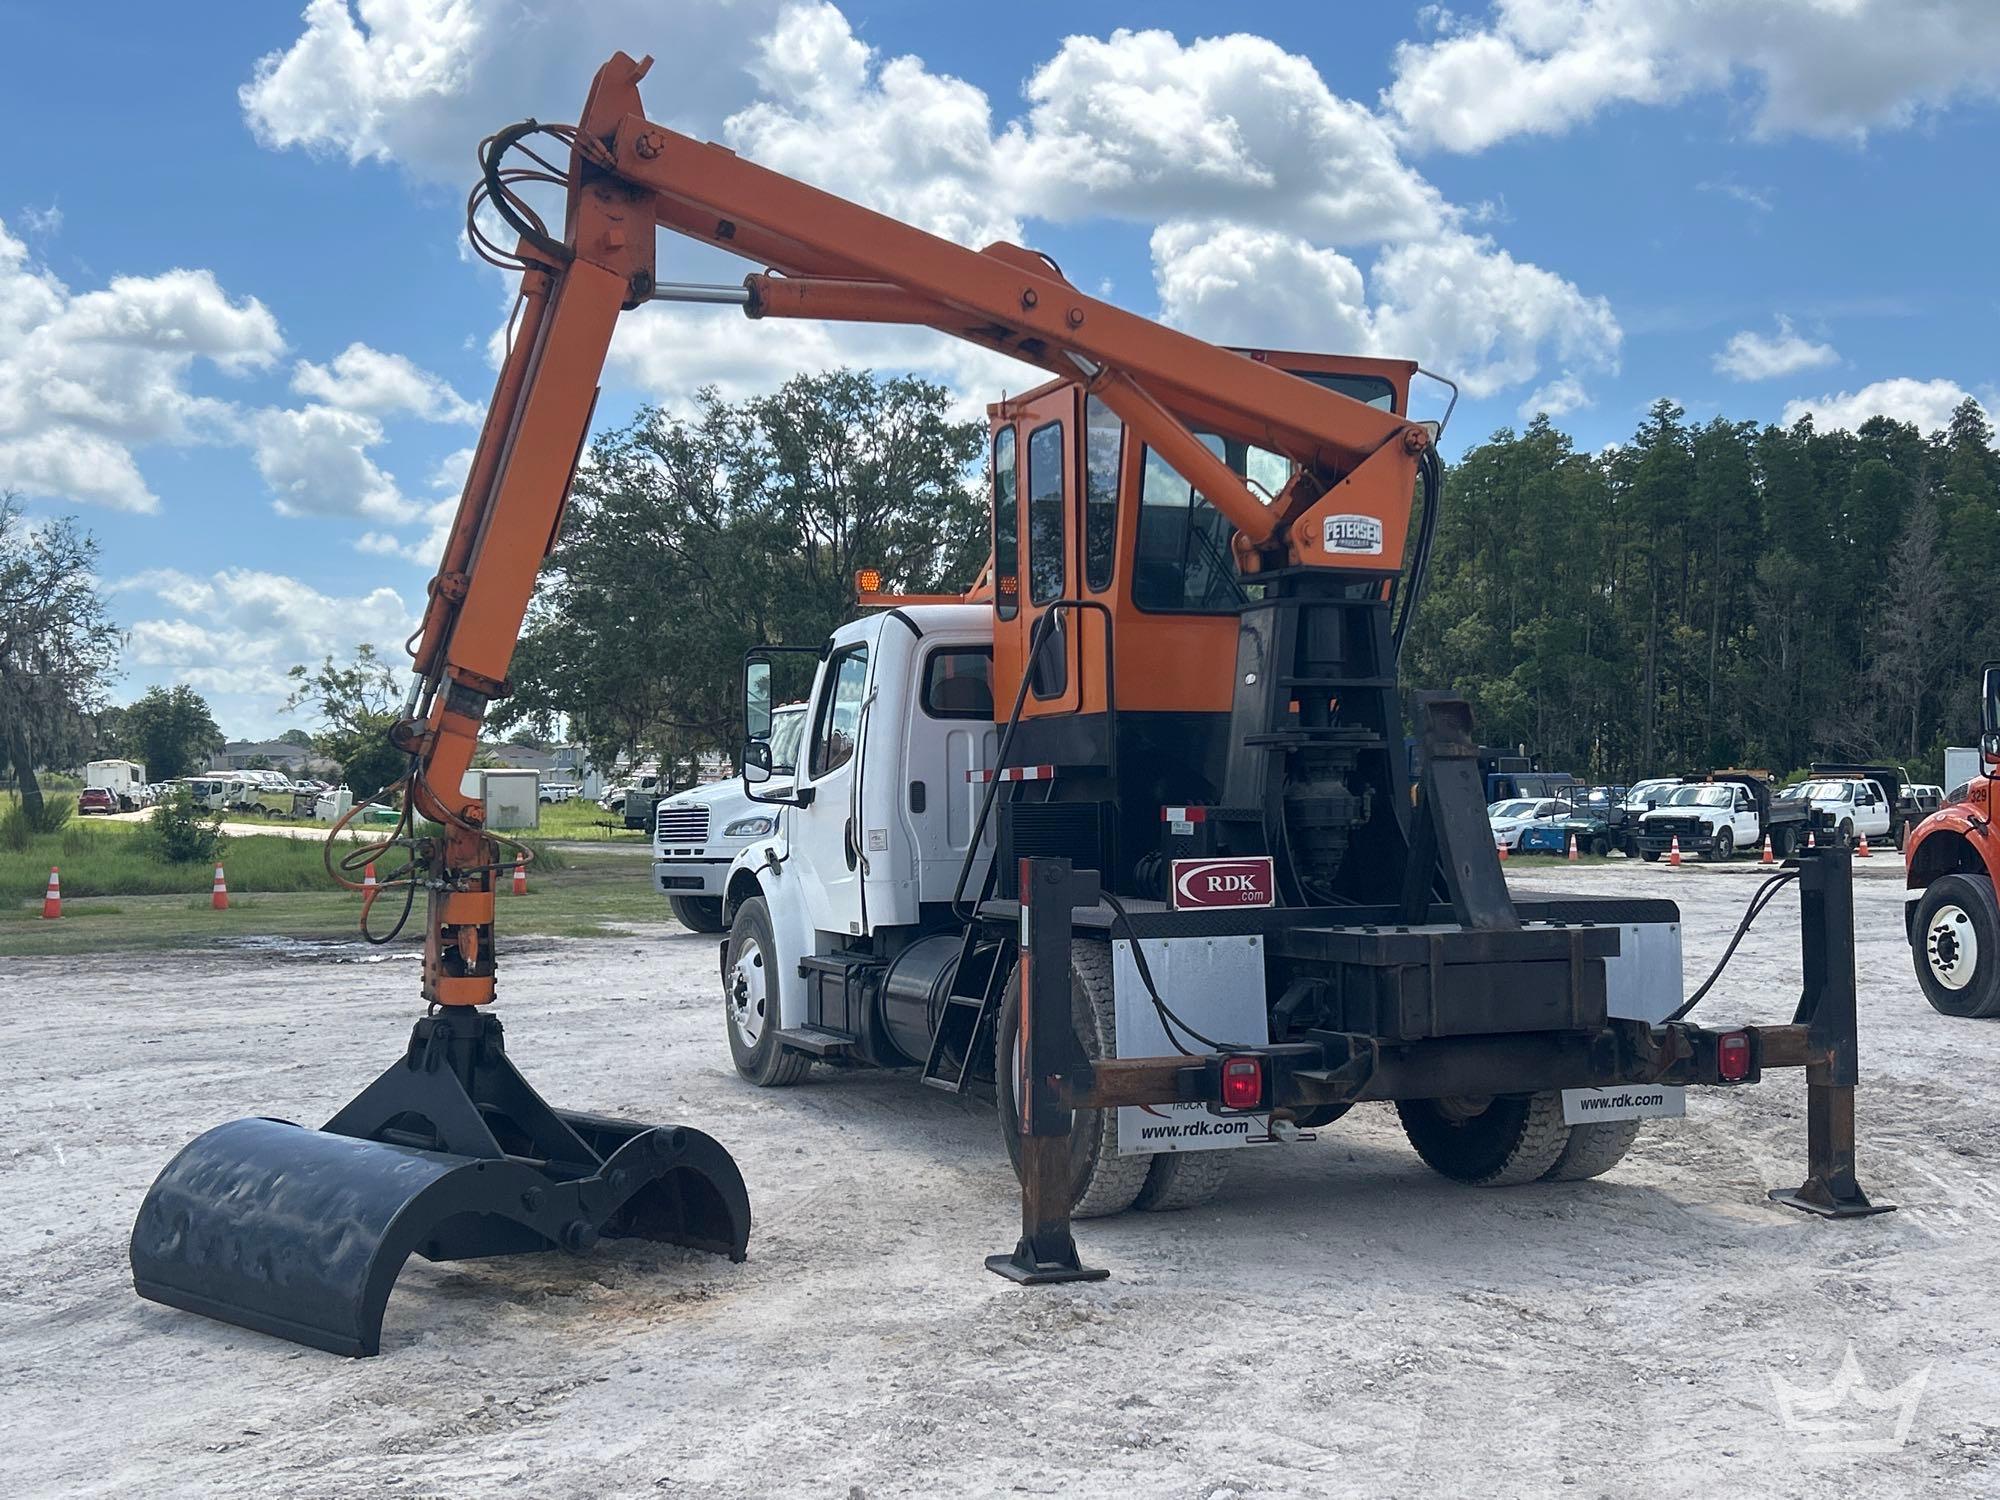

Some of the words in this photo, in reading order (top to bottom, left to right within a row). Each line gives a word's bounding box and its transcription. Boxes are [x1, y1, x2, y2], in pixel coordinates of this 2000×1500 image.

[1326, 521, 1380, 543] PETERSEN
[1971, 789, 1987, 802] 329
[1206, 875, 1256, 892] RDK
[1238, 891, 1264, 902] .com
[1580, 1094, 1663, 1110] www.rdk.com
[1141, 1121, 1249, 1139] www.rdk.com
